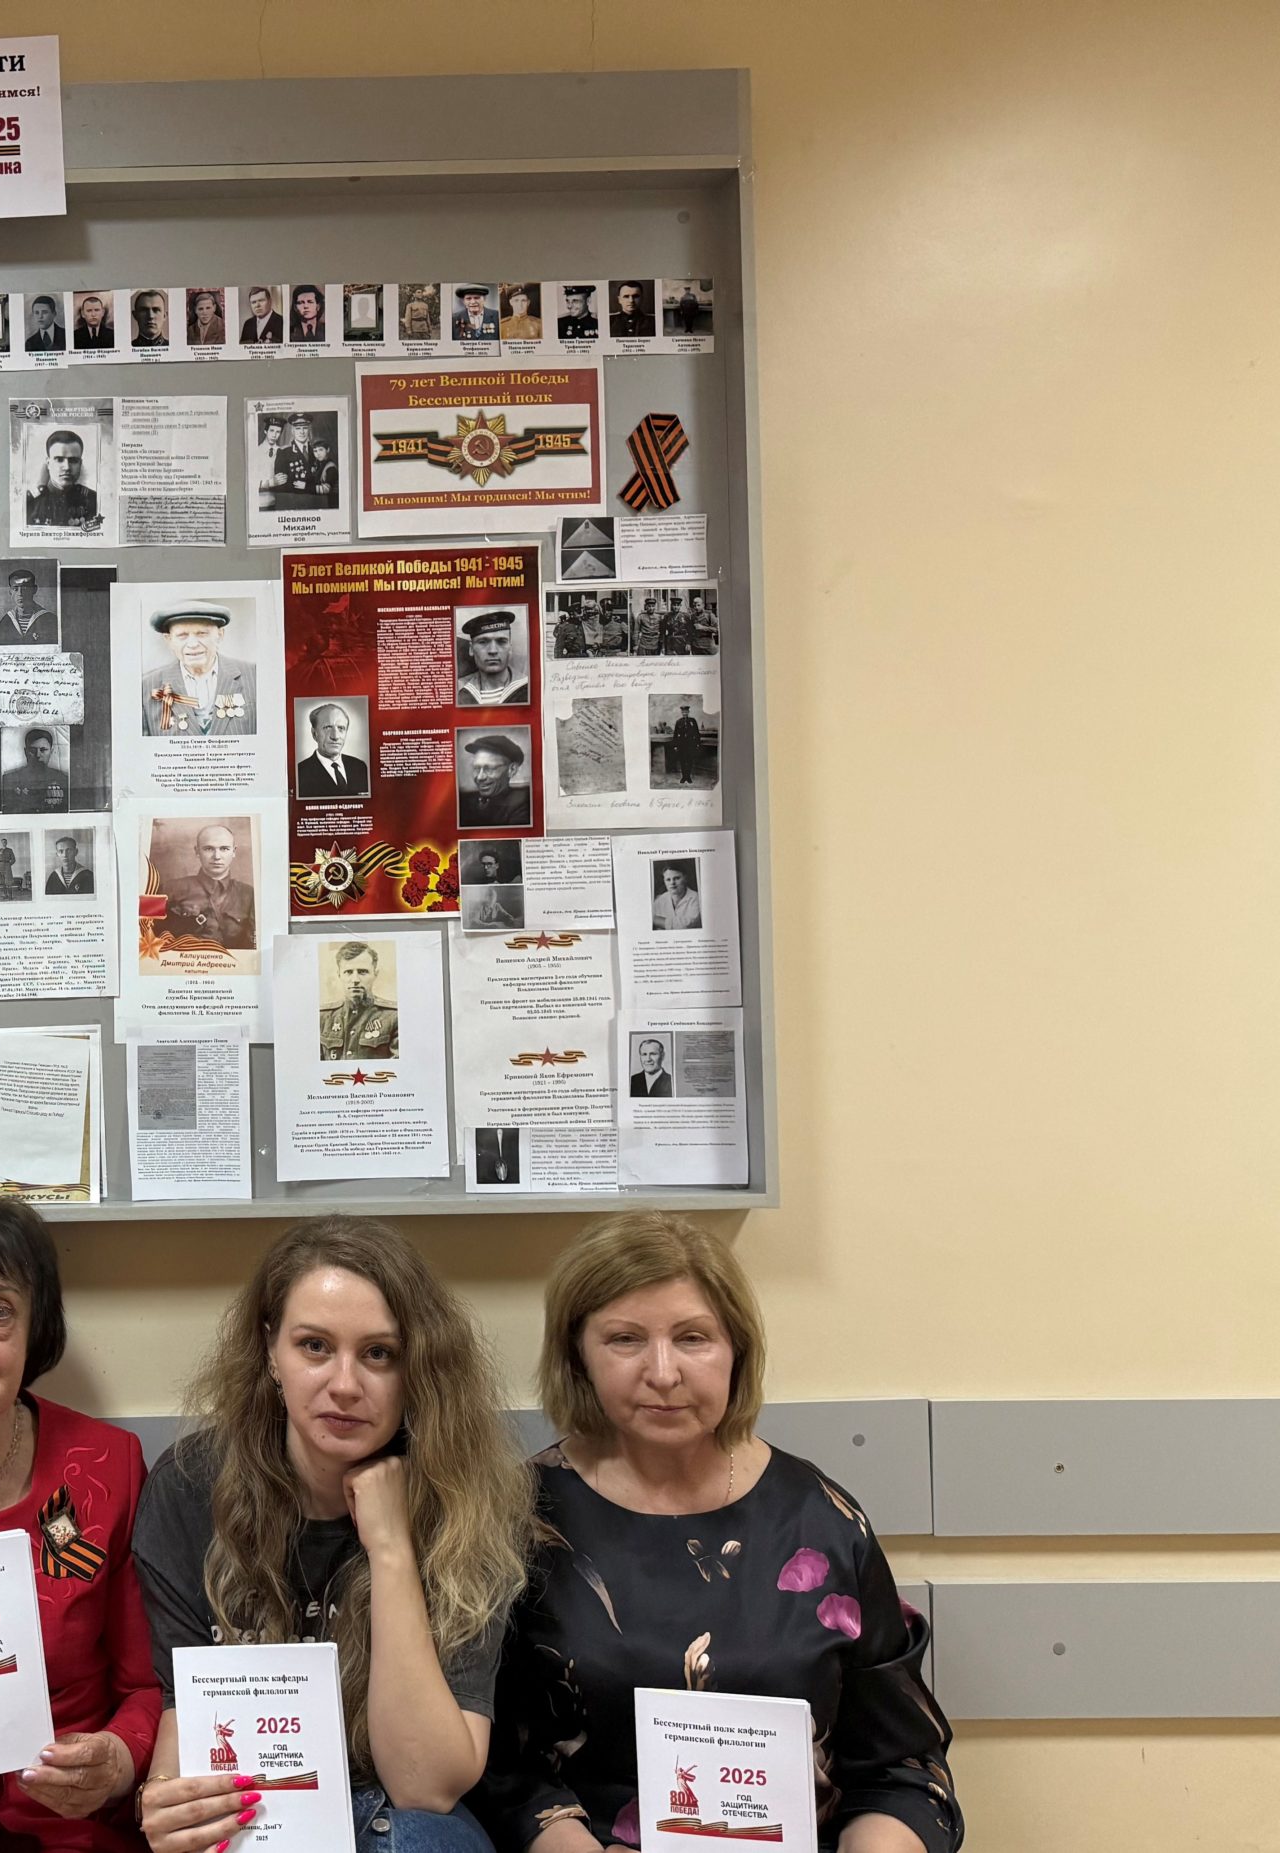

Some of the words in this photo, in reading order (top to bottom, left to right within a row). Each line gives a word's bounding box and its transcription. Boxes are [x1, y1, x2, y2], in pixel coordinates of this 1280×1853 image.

[390, 379, 406, 391] 79
[410, 377, 435, 388] лет
[440, 374, 505, 386] Великой
[510, 373, 569, 385] Победы
[409, 393, 511, 407] Бессмертный
[517, 394, 552, 403] полк
[392, 440, 423, 453] 1941
[538, 434, 570, 448] 1945
[374, 497, 393, 505] Мы
[397, 494, 447, 504] помним!
[451, 493, 470, 502] Мы
[474, 491, 531, 502] гордимся!
[535, 491, 555, 500] Мы
[558, 490, 590, 499] чтим!
[292, 564, 307, 577] 75
[309, 565, 331, 576] лет
[336, 560, 394, 575] Великой
[397, 559, 451, 574] Победы
[454, 558, 482, 571] 1941
[492, 557, 523, 570] 1945
[292, 581, 313, 594] Мы
[316, 579, 369, 594] помним!
[374, 579, 394, 592] Мы
[397, 577, 461, 592] гордимся!
[466, 575, 487, 588] Мы
[490, 574, 524, 588] чтим!
[192, 1675, 247, 1684] Бессмертный
[271, 1675, 308, 1684] кафедры
[203, 1688, 251, 1697] германской
[253, 1687, 299, 1697] филологии
[256, 1717, 301, 1733] 2025
[653, 1718, 711, 1732] Бессмертный
[714, 1726, 735, 1734] полк
[737, 1727, 776, 1737] кафедры
[665, 1733, 715, 1745] германской
[718, 1738, 766, 1748] филологии
[210, 1748, 222, 1761] 80
[258, 1752, 303, 1760] ЗАЩИТНИКА
[211, 1763, 238, 1771] ПОБЕДА!
[720, 1767, 766, 1786] 2025
[670, 1791, 684, 1805] 80
[737, 1794, 752, 1802] ГОД
[671, 1806, 699, 1816] ПОБЕДА!
[721, 1801, 768, 1811] ЗАЩИТНИКА
[722, 1809, 767, 1819] ОТЕЧЕСТВА
